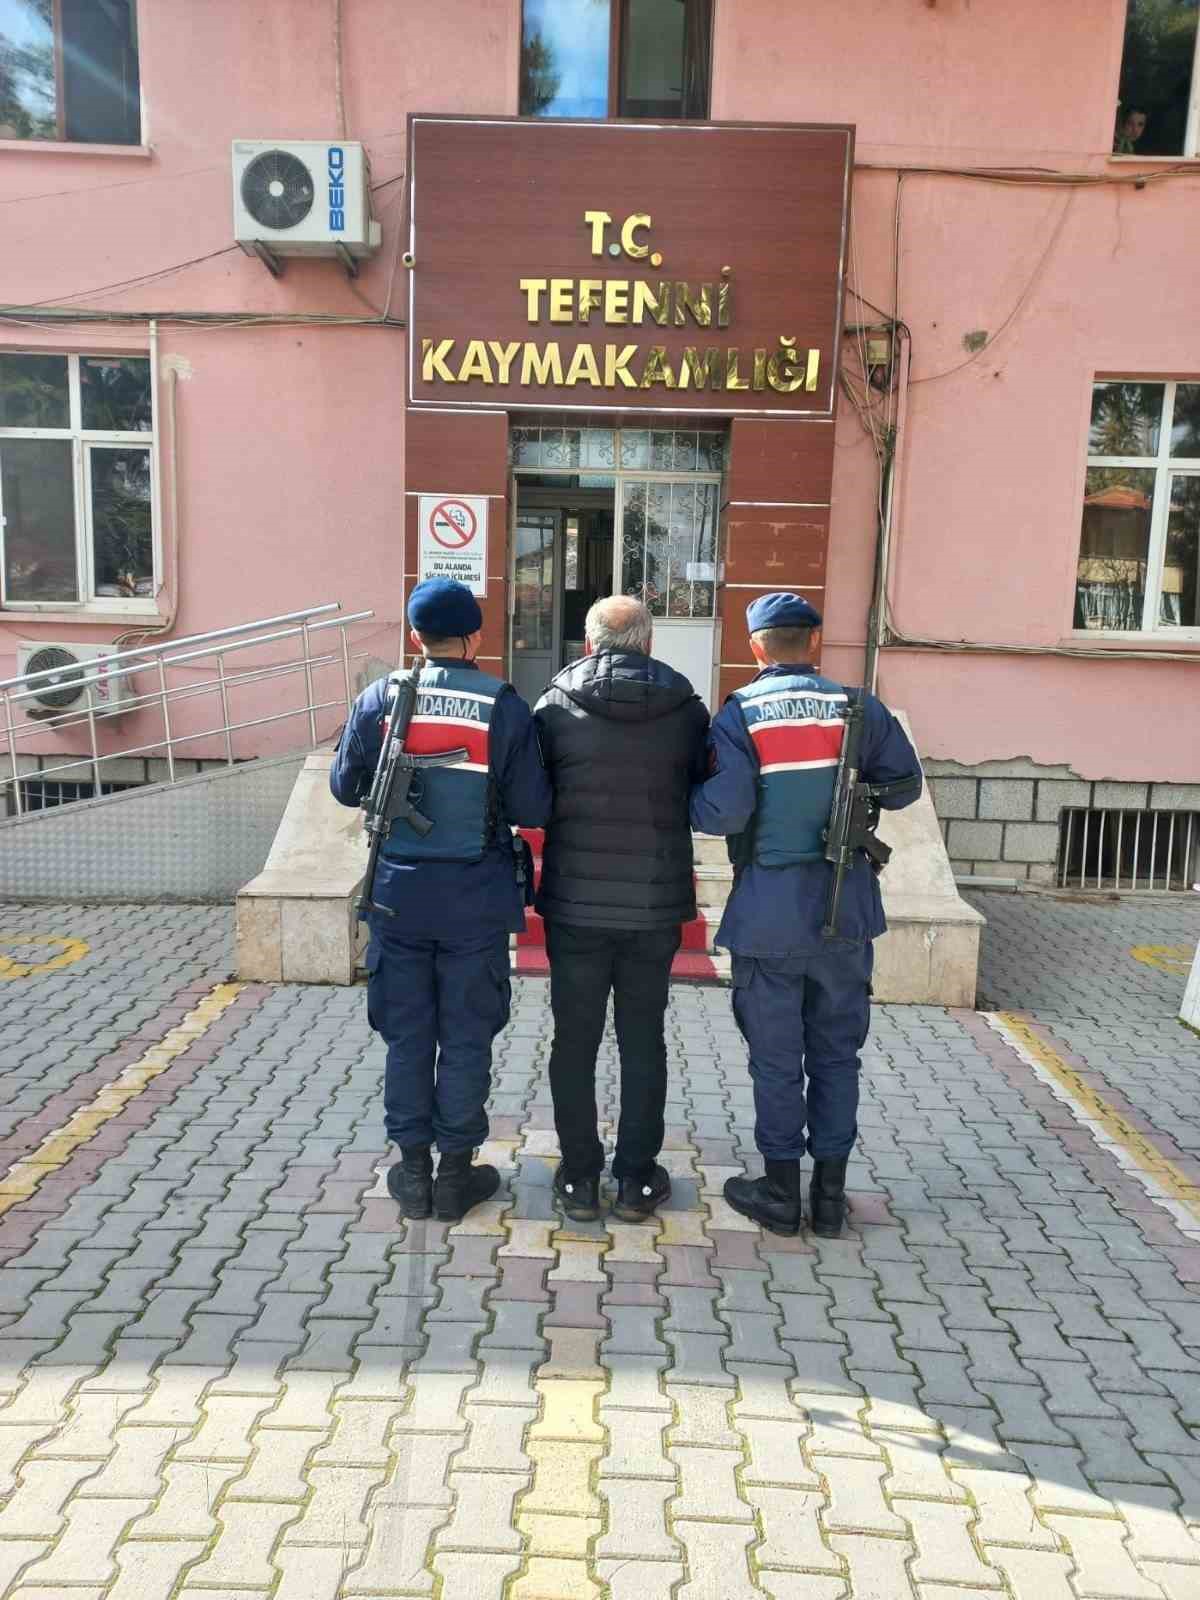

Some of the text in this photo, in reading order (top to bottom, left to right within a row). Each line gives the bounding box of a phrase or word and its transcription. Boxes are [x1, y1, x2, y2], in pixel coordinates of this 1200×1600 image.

[328, 147, 345, 231] BEKO
[519, 265, 735, 328] TEFENNİ
[422, 335, 821, 393] KAYMAKAMLIĞI
[444, 563, 472, 571] ALANDA
[415, 695, 480, 720] NDARMA
[756, 698, 839, 721] JANDARMA
